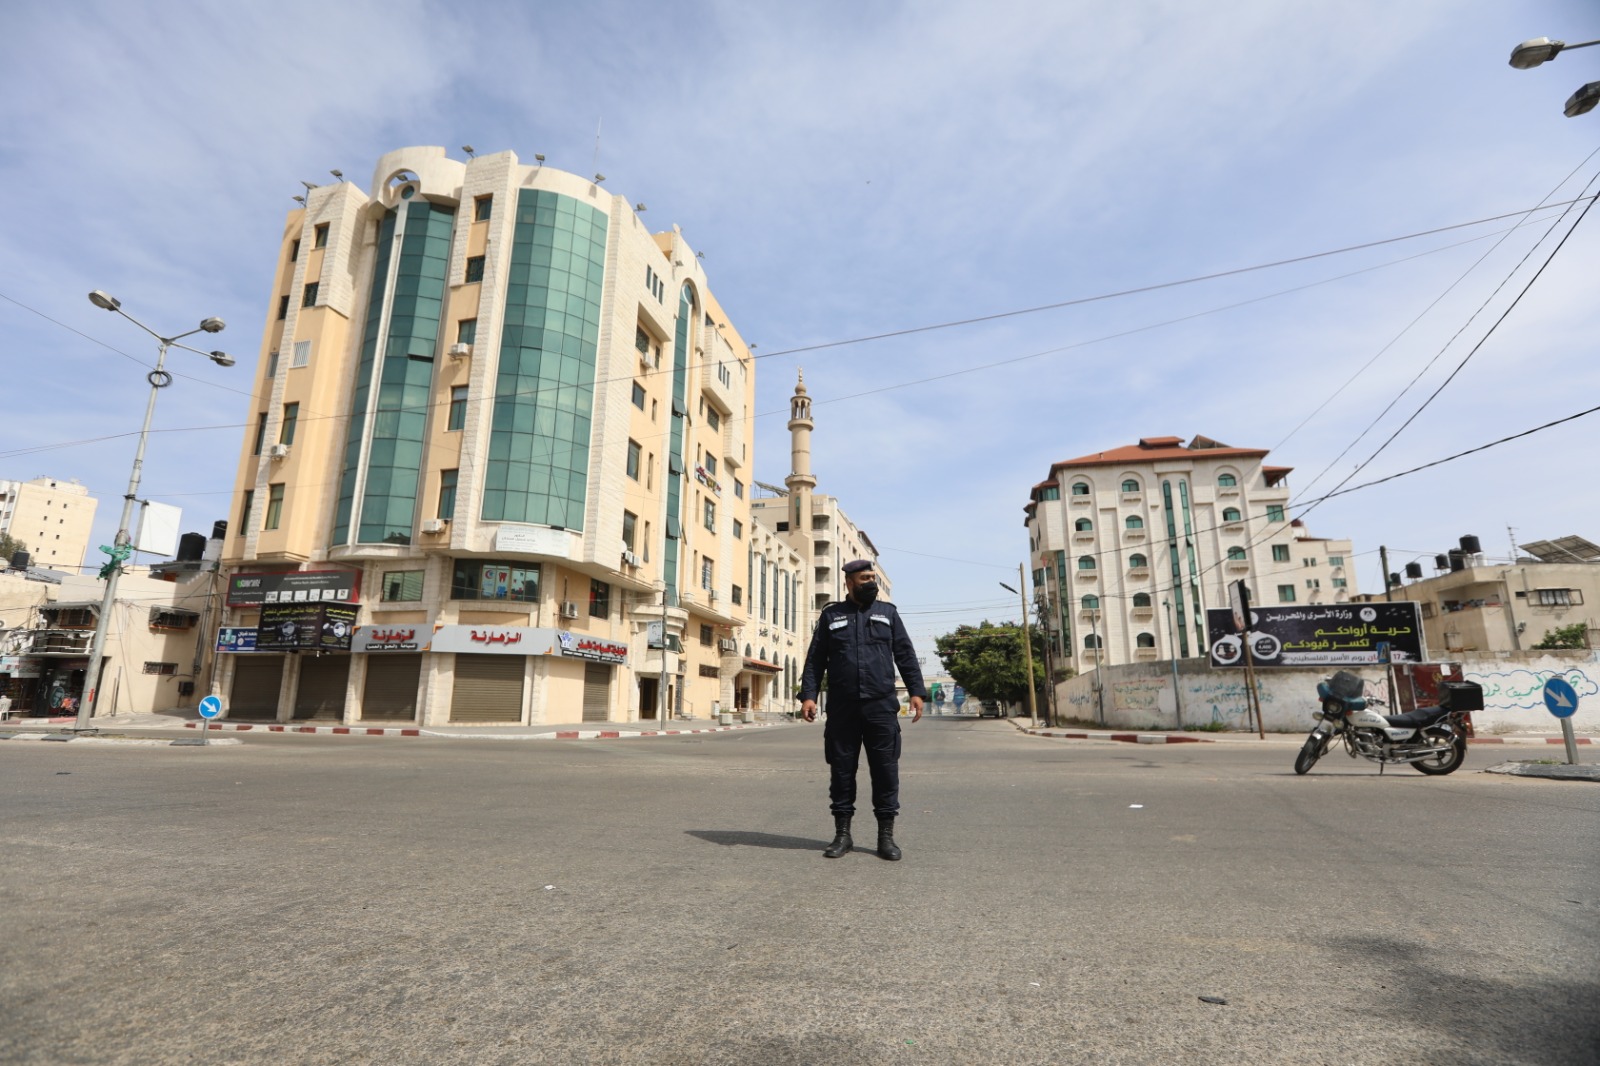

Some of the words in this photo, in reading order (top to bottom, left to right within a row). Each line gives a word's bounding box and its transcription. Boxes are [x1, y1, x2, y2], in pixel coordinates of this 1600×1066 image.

[1265, 611, 1306, 622] والمحررين
[1307, 609, 1335, 620] الأسرى
[1336, 609, 1353, 619] وزارة
[371, 629, 415, 642] الزهارنة
[1314, 623, 1368, 638] أرواحكم
[1369, 625, 1411, 637] حرية
[470, 630, 522, 645] الزهارنة
[1282, 640, 1330, 651] قيودكم
[1332, 638, 1370, 650] تكسر
[1290, 653, 1328, 662] الفلسطيني
[1330, 653, 1350, 662] الأسير
